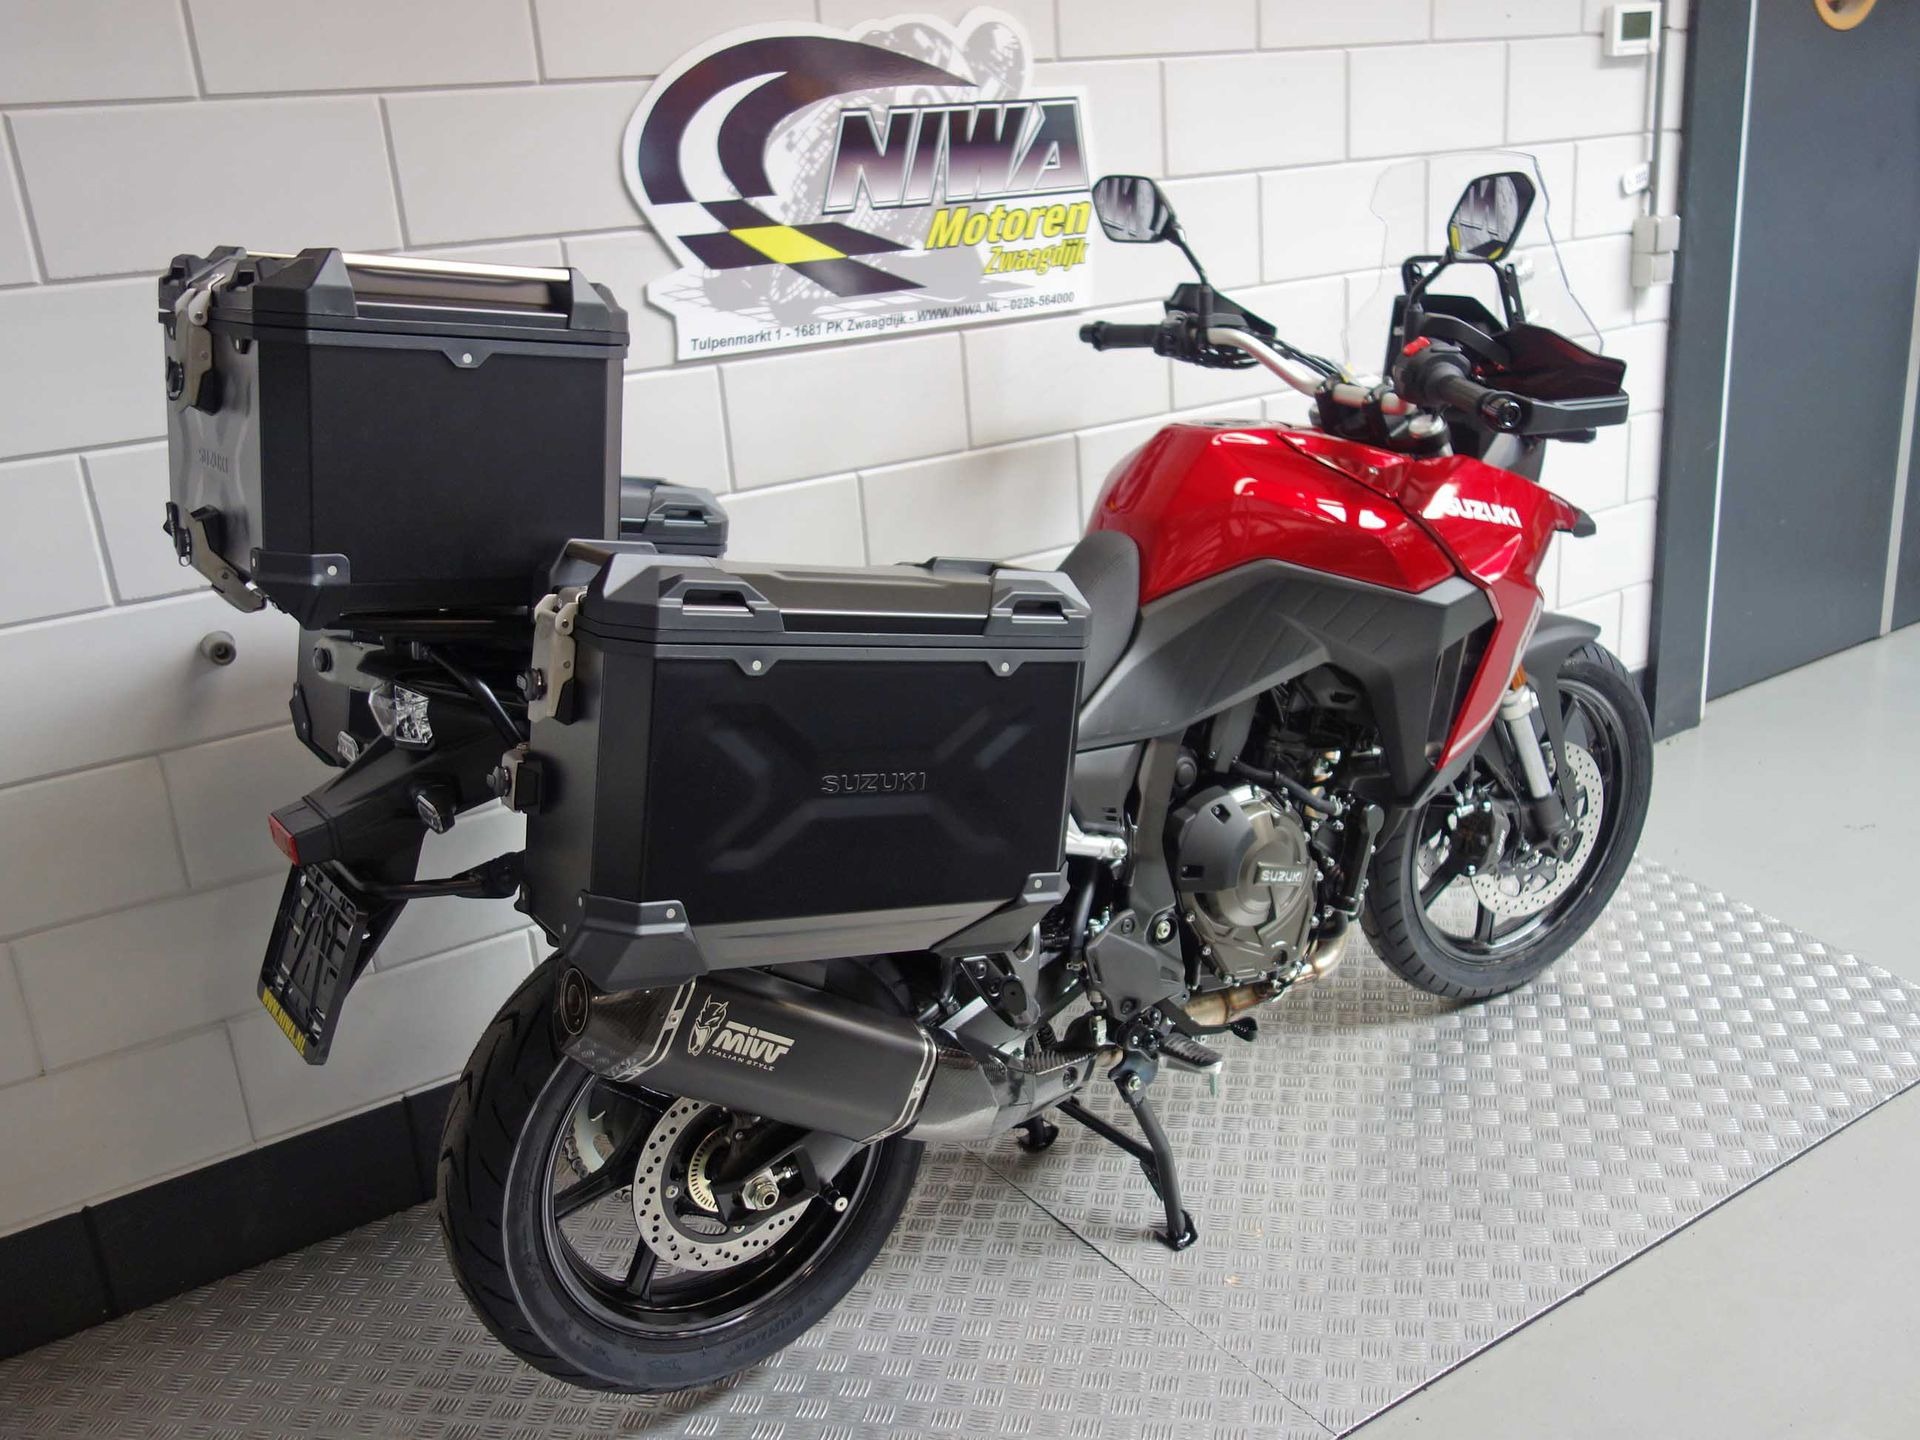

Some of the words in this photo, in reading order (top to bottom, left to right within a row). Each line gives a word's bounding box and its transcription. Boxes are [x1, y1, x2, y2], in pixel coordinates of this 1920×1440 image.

[822, 97, 1091, 214] NIWA
[925, 201, 1092, 250] Motoren
[983, 237, 1089, 276] Zwaagdijk
[691, 330, 771, 351] Tulpenmarkt
[776, 329, 782, 340] 1
[795, 325, 822, 338] 1681
[826, 321, 843, 334] PK
[847, 312, 906, 332] Zwaagdijk
[917, 301, 999, 321] WWW.NIWA.NL
[820, 771, 927, 794] SUZUKI
[1261, 870, 1303, 882] SUZUKI
[707, 1048, 745, 1063] ITALIAN
[746, 1059, 776, 1072] STYLE
